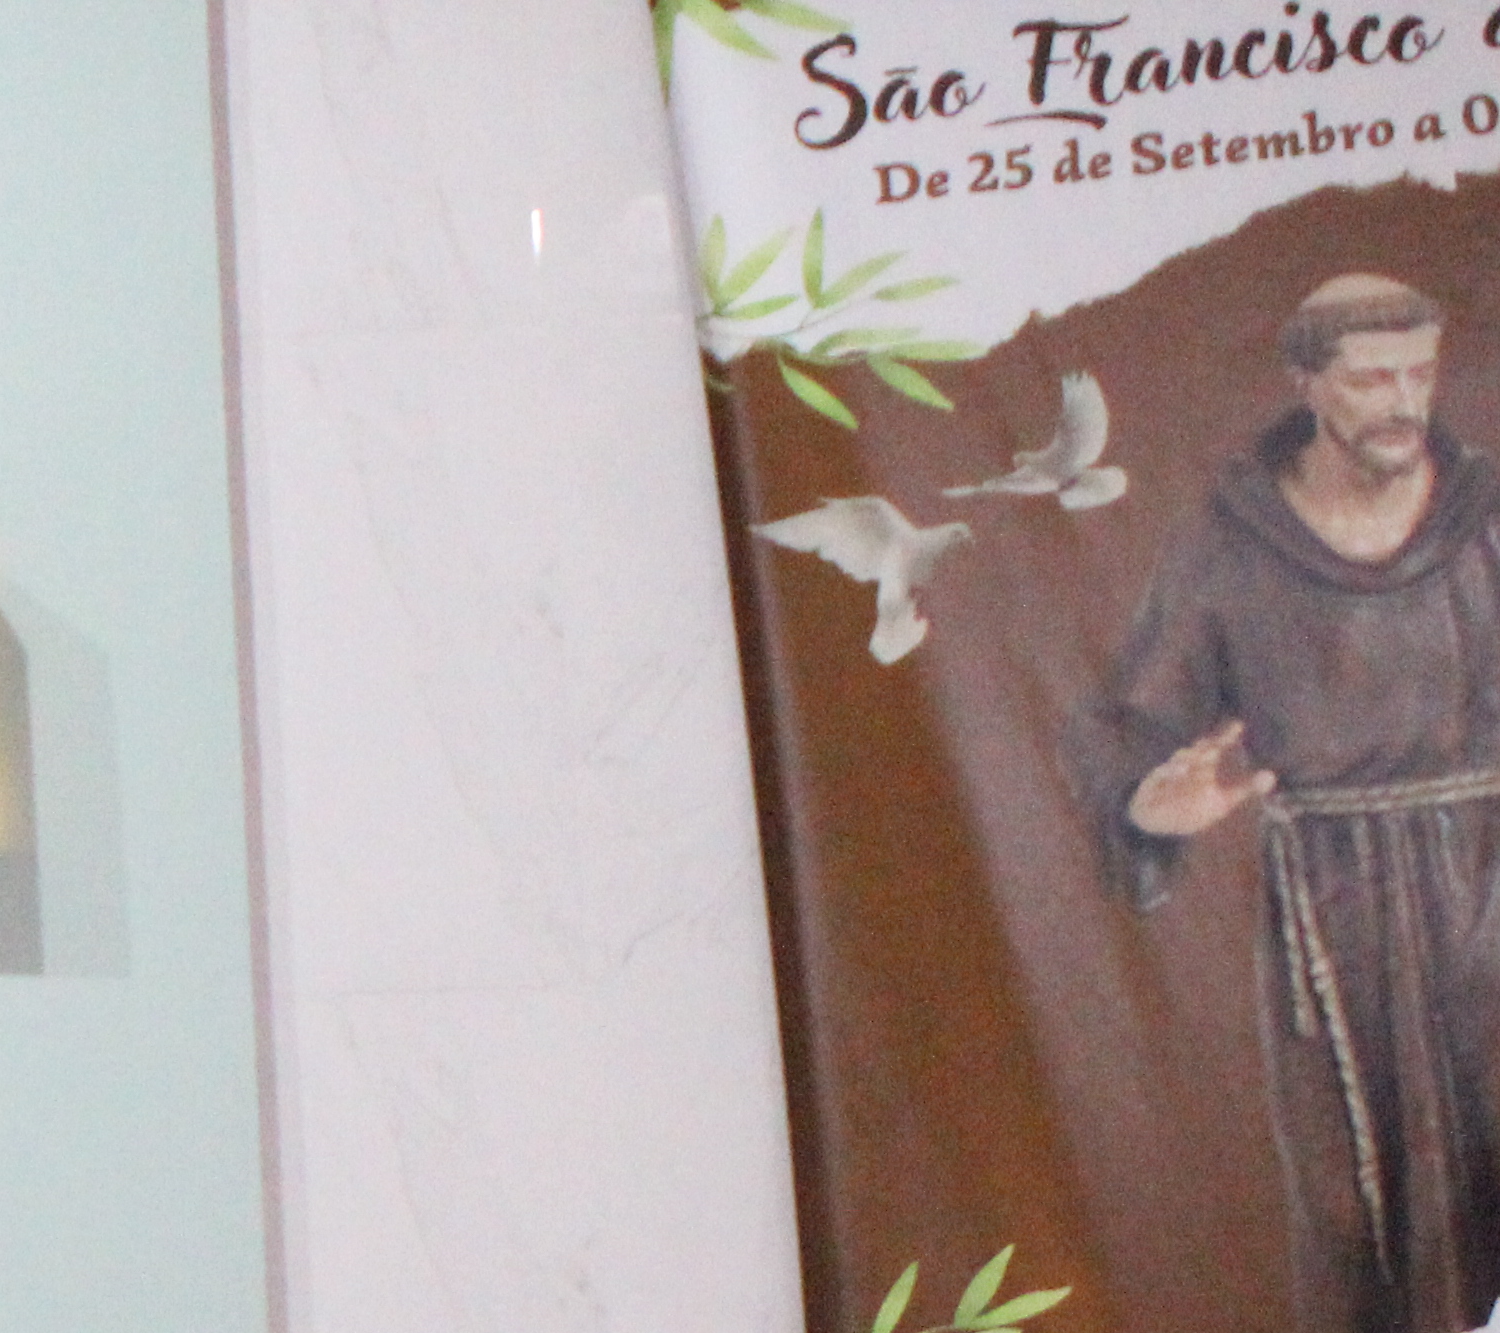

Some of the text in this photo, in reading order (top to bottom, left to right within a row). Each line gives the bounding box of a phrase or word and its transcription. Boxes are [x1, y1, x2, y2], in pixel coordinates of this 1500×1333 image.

[794, 1, 1445, 151] São Francisco
[874, 162, 949, 204] De
[968, 145, 1033, 193] 25
[1053, 138, 1111, 182] de
[1131, 110, 1395, 176] Setembro
[1413, 112, 1446, 143] a
